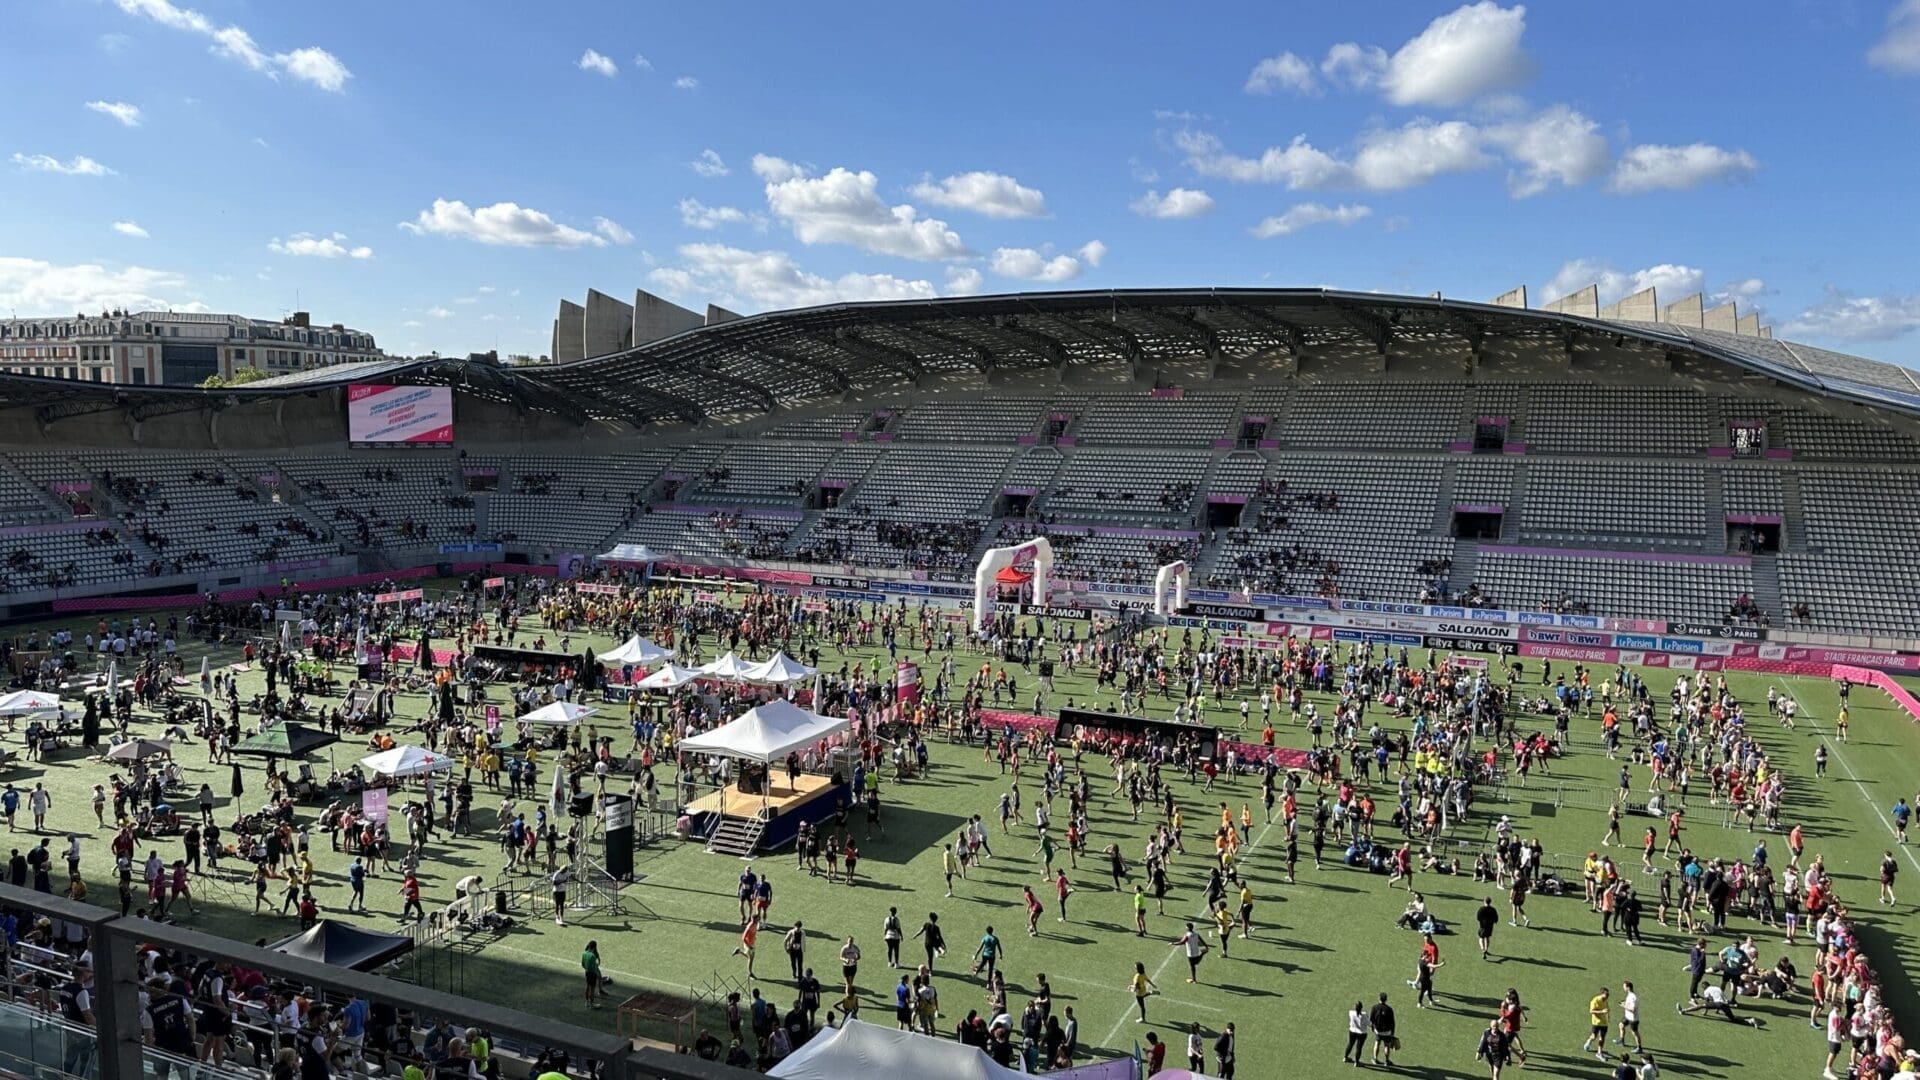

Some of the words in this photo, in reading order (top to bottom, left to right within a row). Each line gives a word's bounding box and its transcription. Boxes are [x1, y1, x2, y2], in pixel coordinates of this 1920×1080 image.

[1196, 605, 1257, 618] SALOMON
[1438, 624, 1510, 637] SALOMON
[1688, 627, 1712, 635] PARIS
[1428, 637, 1453, 648] Cityz
[1457, 640, 1483, 651] Cityz
[1538, 632, 1560, 641] BWT
[1578, 635, 1601, 644] BWT
[1626, 637, 1653, 648] Parisien
[1672, 641, 1699, 651] Parisien
[1530, 646, 1552, 656] STADE
[1585, 650, 1606, 660] PARIS
[1824, 652, 1847, 661] STADE
[1883, 657, 1906, 666] PARIS
